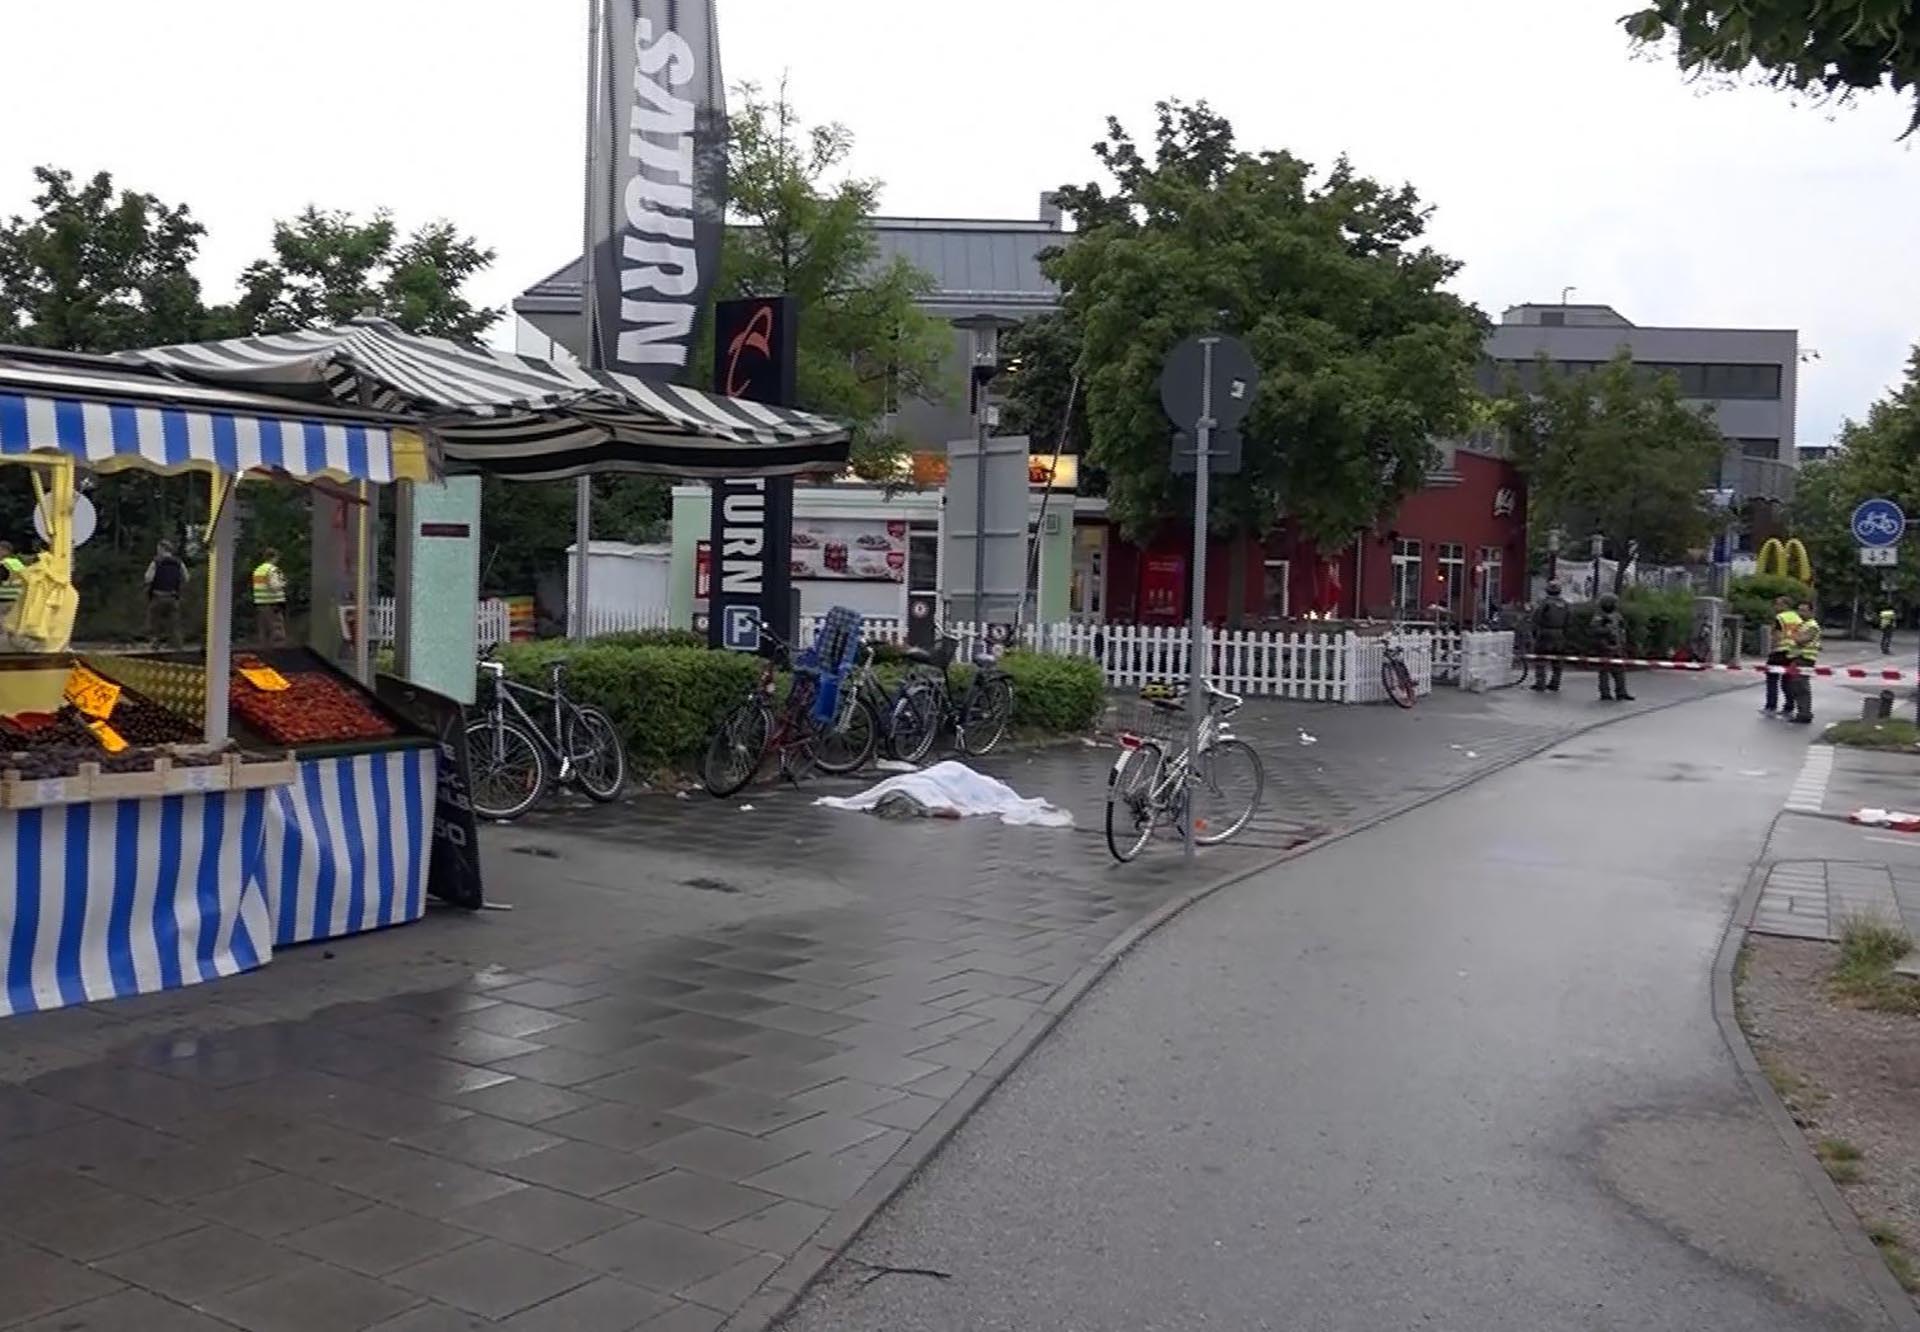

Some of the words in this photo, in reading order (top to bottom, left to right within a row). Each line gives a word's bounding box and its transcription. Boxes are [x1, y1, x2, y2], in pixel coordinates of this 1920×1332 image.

[617, 17, 698, 366] SATURN
[722, 477, 766, 594] TURN
[733, 611, 753, 643] P
